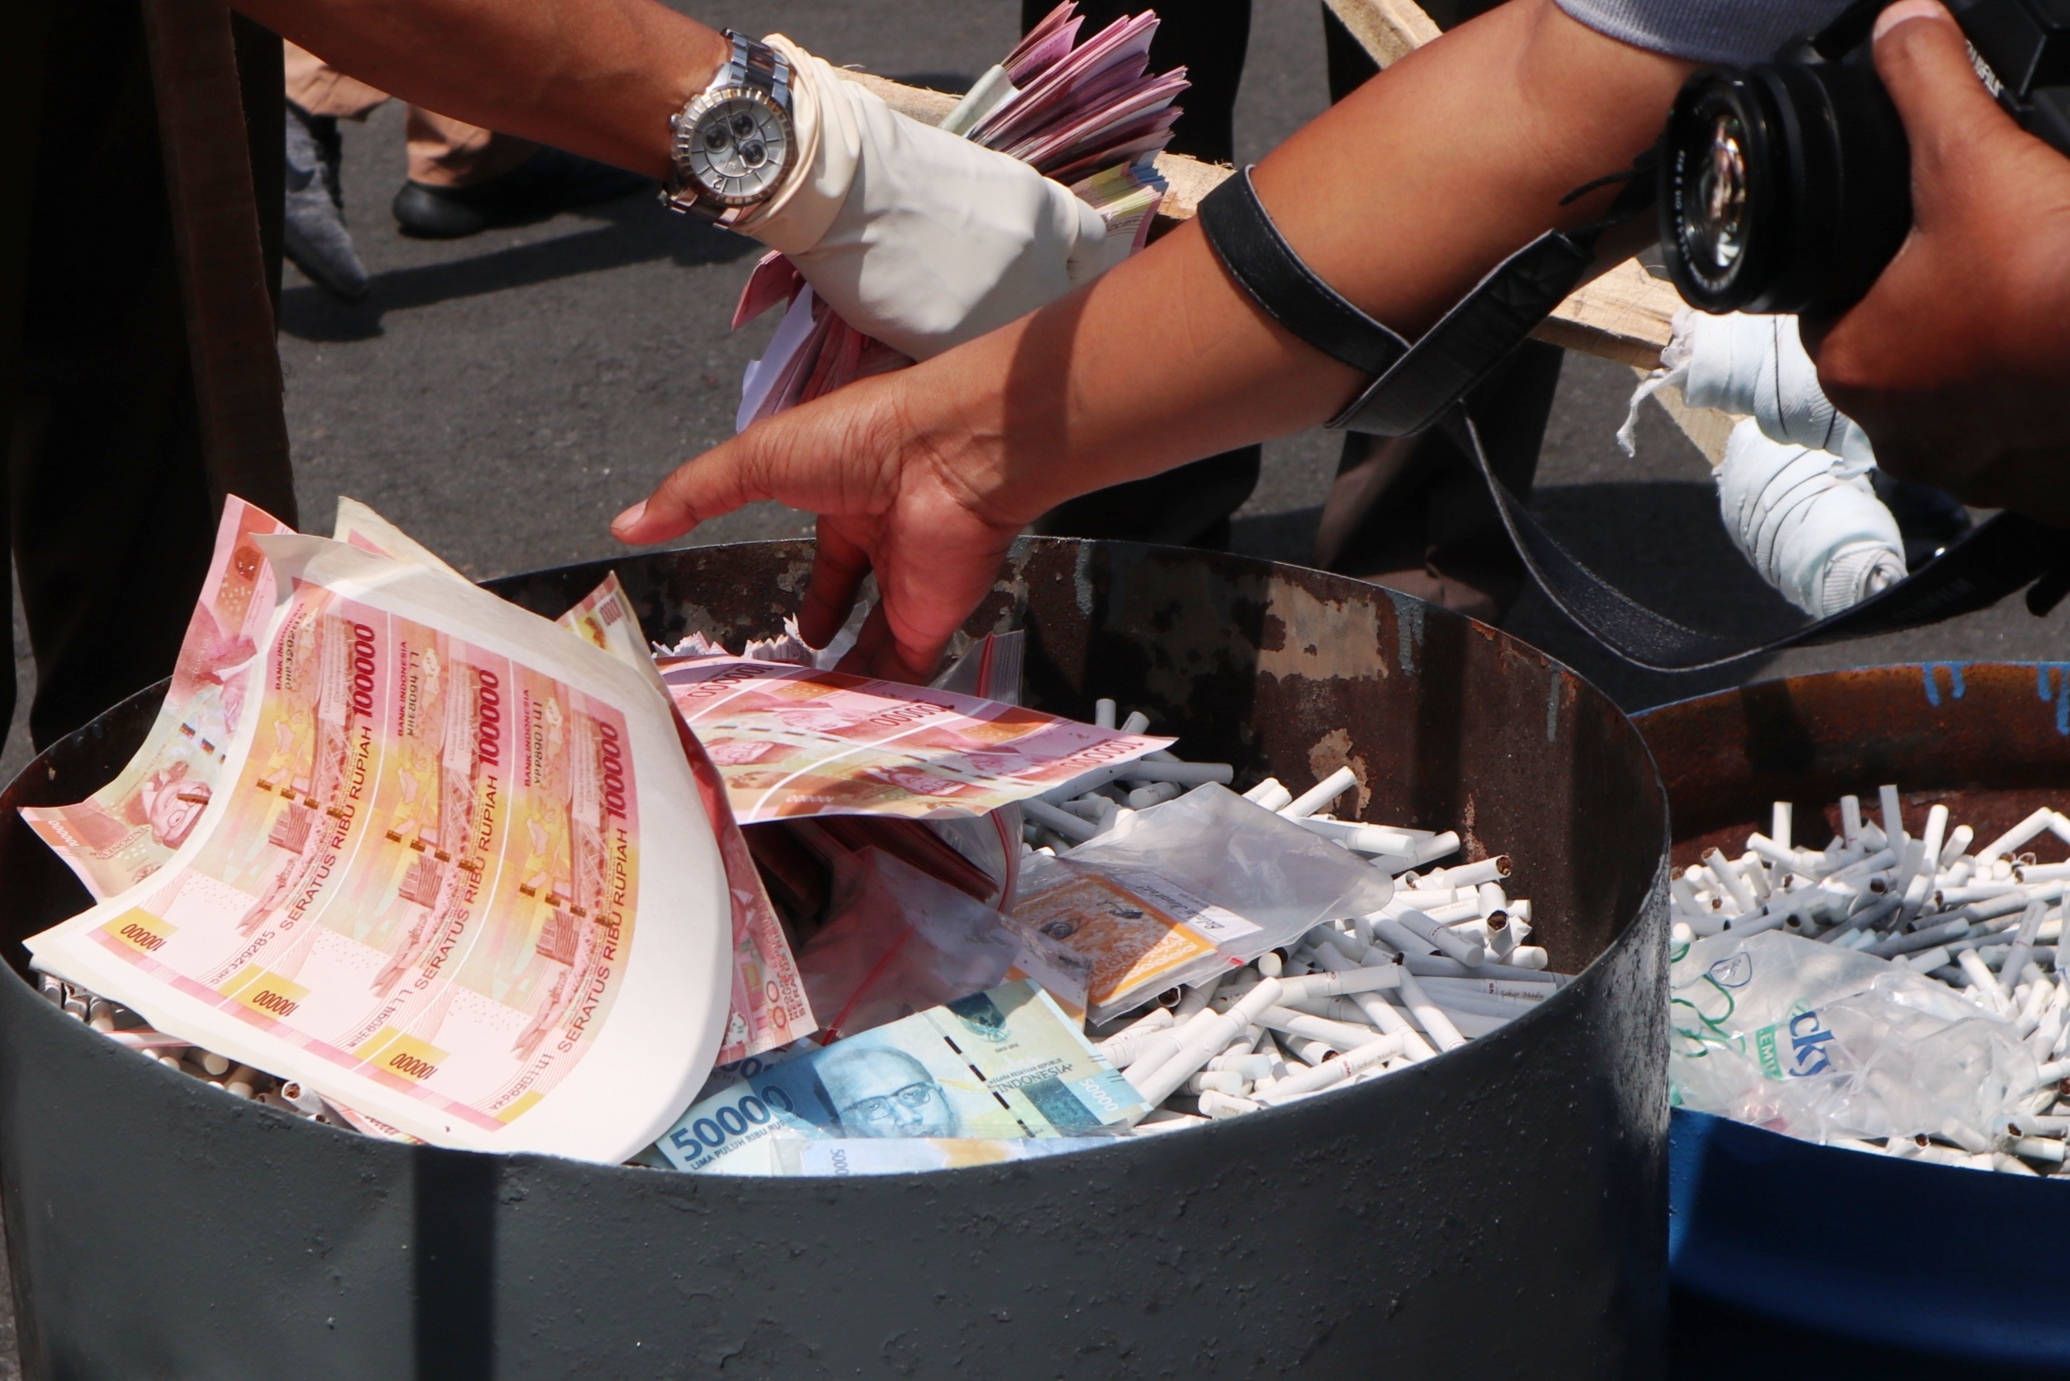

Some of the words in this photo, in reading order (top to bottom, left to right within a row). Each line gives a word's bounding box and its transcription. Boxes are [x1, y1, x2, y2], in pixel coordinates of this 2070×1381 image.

[353, 624, 375, 718] 100000
[478, 670, 500, 767] 100000
[523, 689, 531, 751] INDONESIA
[524, 755, 532, 786] BANK
[600, 722, 626, 819] 100000
[280, 854, 336, 930] SERATUS
[331, 806, 356, 850] RIBU
[350, 726, 372, 802] RUPIAH
[414, 908, 470, 990] SERATUS
[465, 857, 486, 905] RIBU
[479, 776, 498, 852] RUPIAH
[120, 923, 167, 951] 100000
[558, 965, 610, 1053] SERATUS
[602, 911, 623, 961] RIBU
[614, 829, 628, 904] RUPIAH
[252, 990, 299, 1017] 100000
[389, 1053, 439, 1080] 100000
[996, 1063, 1073, 1094] INDONESIA
[1079, 1078, 1119, 1112] 50000
[670, 1085, 794, 1162] 50000
[690, 1154, 714, 1171] LIMA
[715, 1138, 745, 1158] PULUH
[745, 1126, 768, 1143] RIBU
